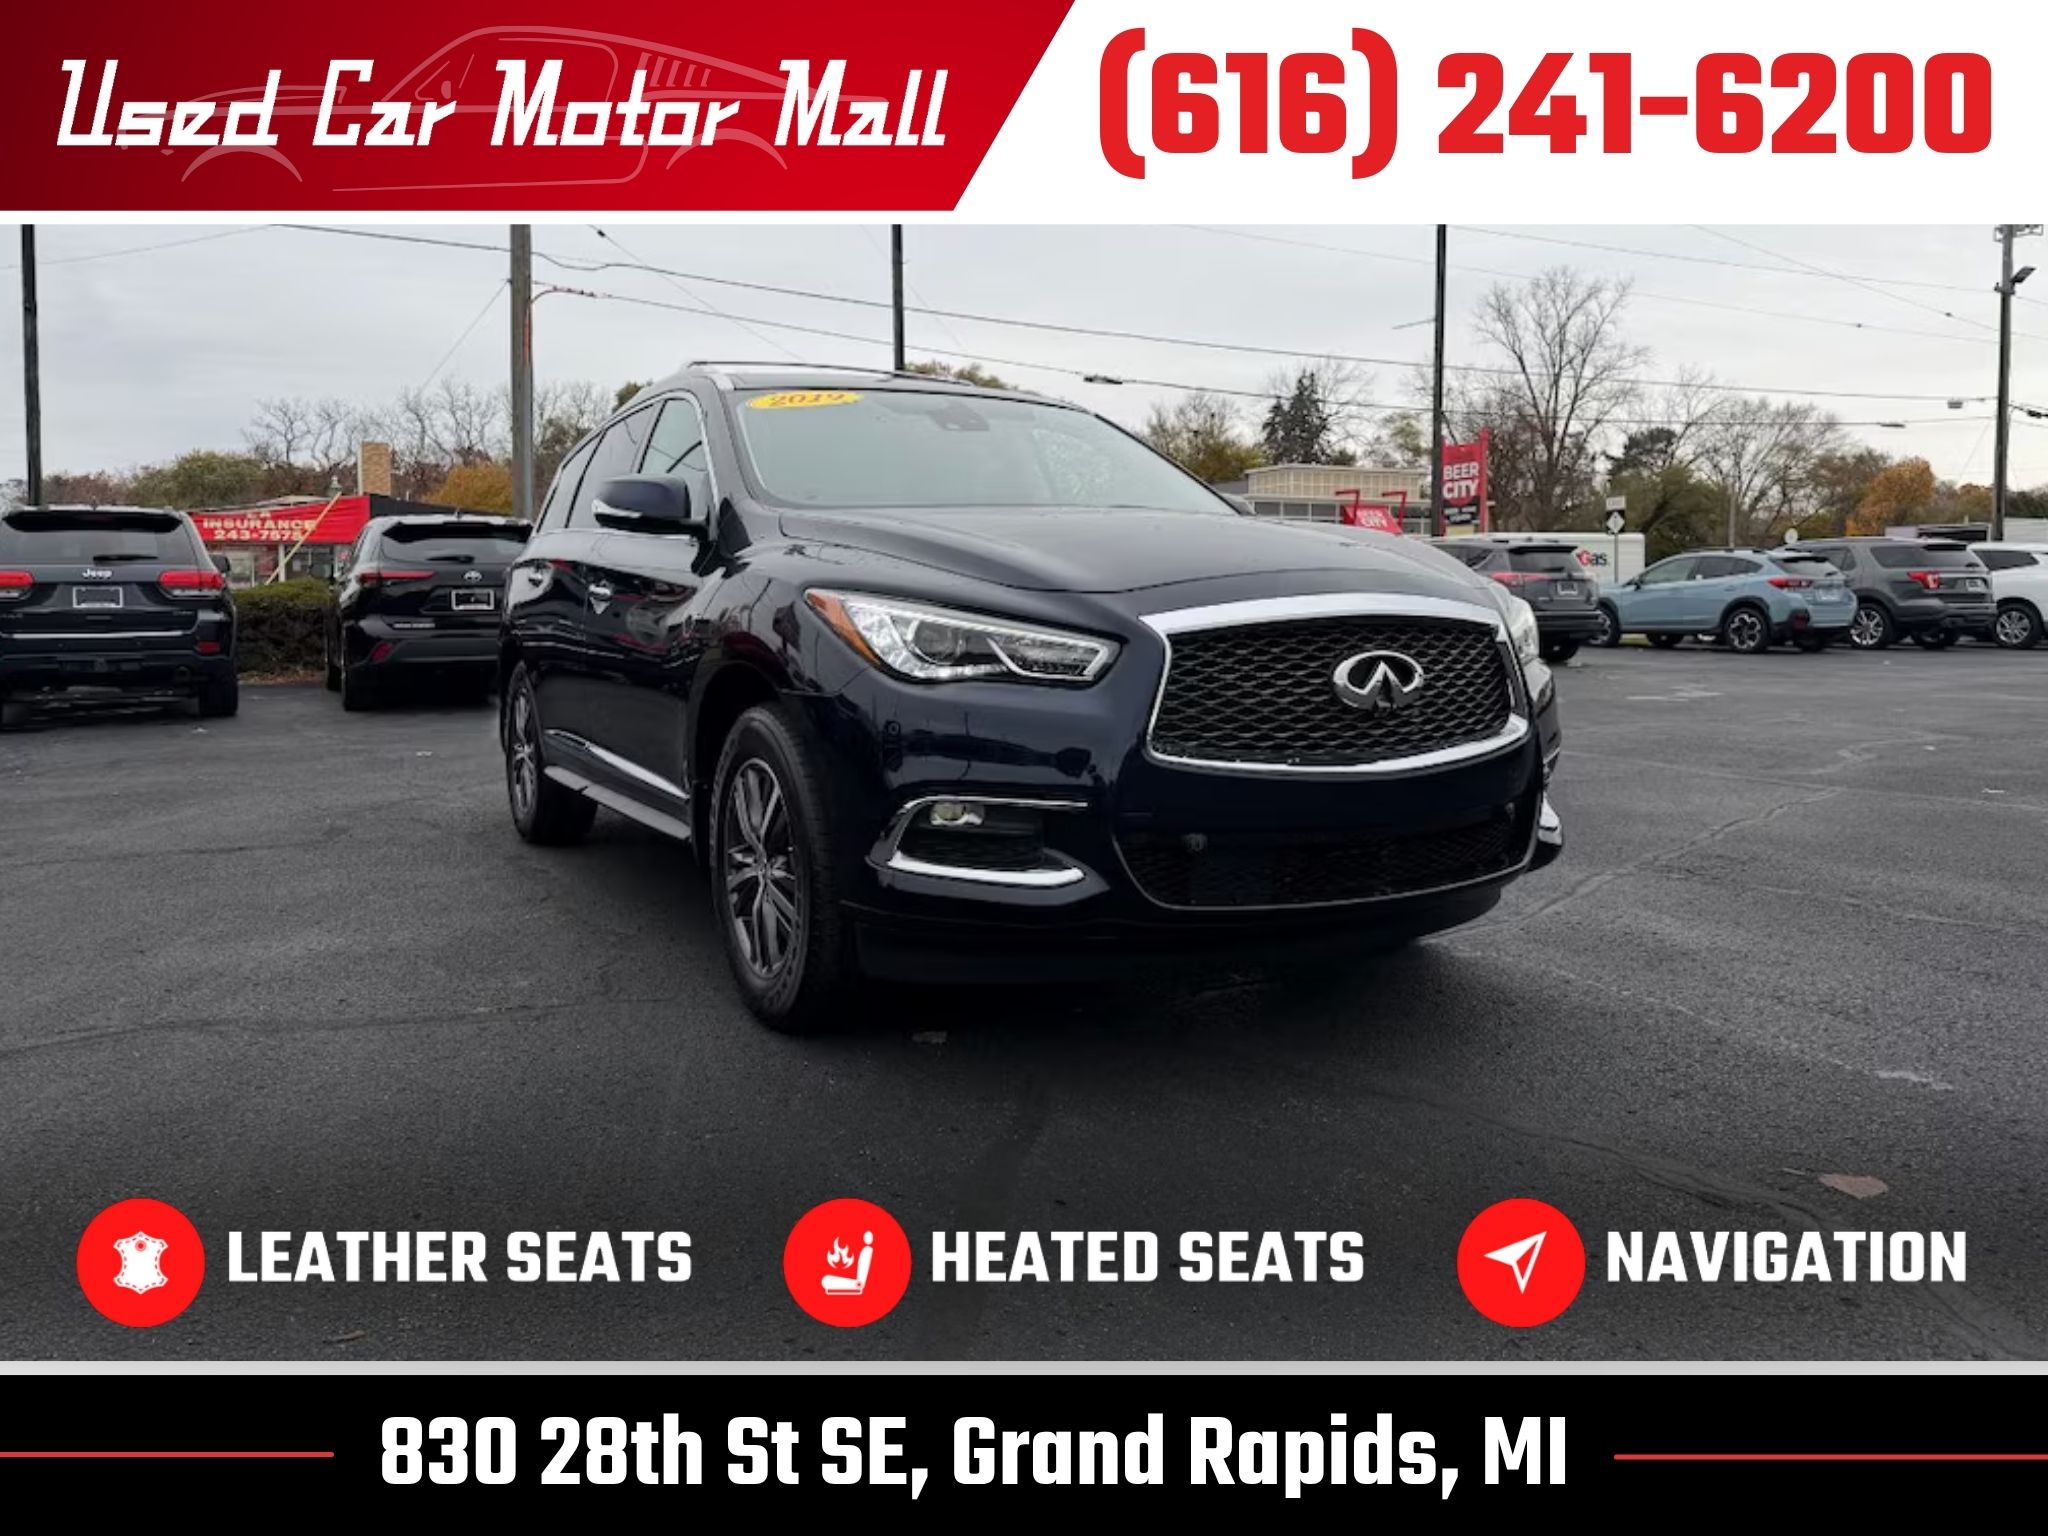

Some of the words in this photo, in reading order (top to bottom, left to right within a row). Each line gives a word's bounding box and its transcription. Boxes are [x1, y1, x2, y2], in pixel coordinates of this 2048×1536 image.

[1443, 462, 1480, 480] BEER
[1443, 479, 1479, 499] CITY
[203, 518, 316, 530] INSURANCE
[83, 569, 113, 579] Jeep
